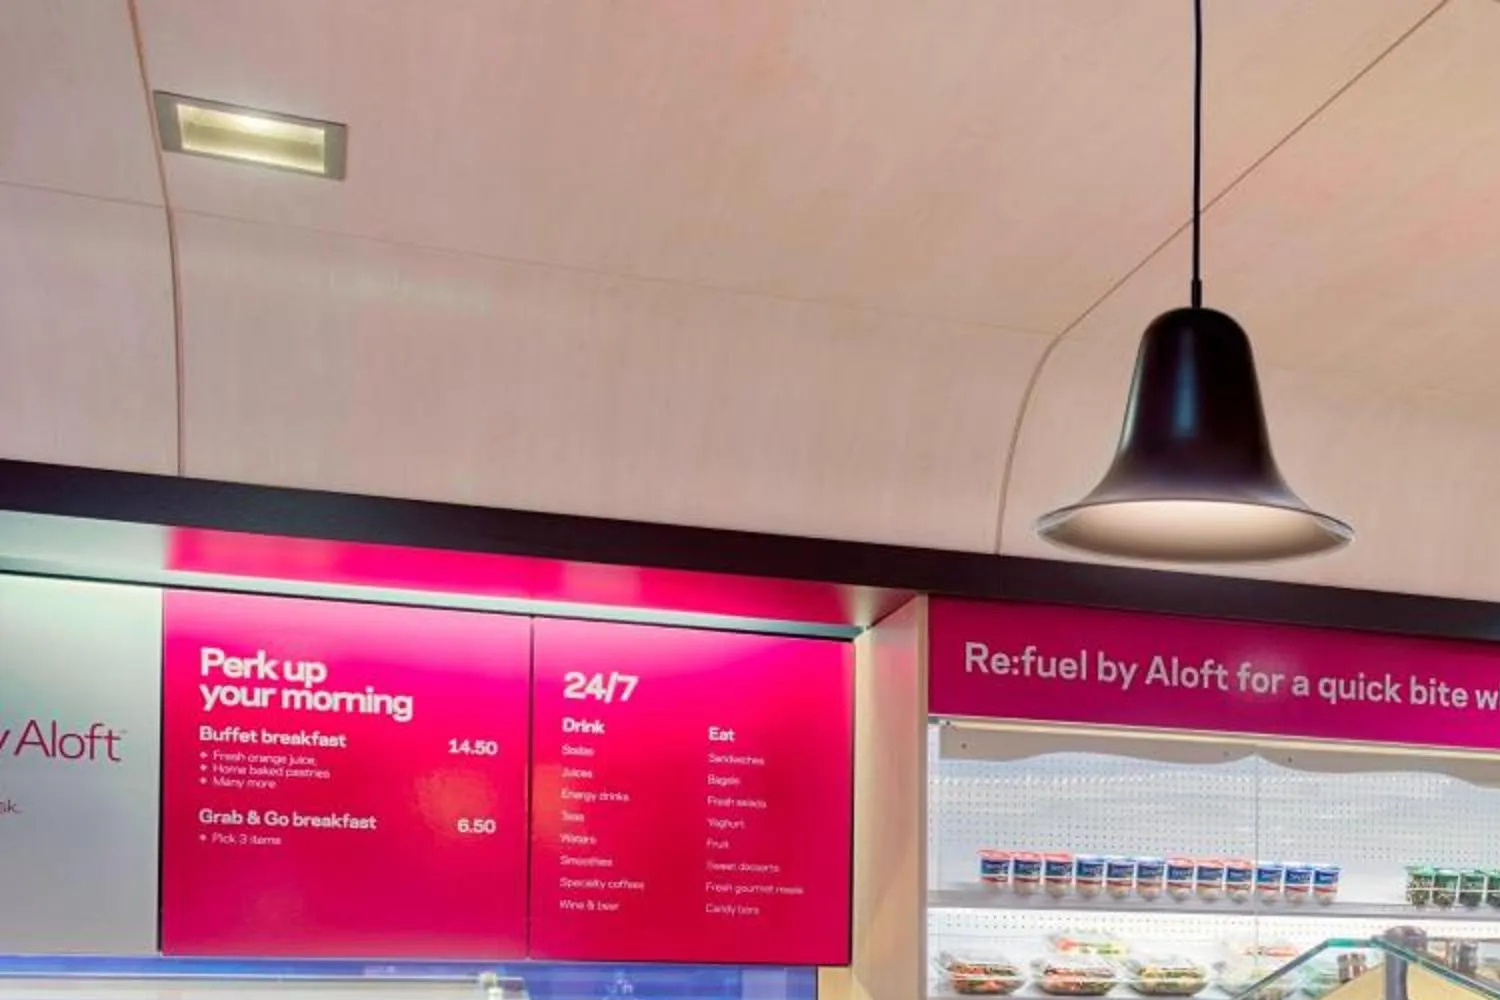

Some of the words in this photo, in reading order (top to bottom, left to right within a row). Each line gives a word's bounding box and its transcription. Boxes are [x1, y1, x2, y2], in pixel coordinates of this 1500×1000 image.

[200, 647, 279, 682] Perk
[283, 658, 327, 688] up
[964, 641, 1088, 681] Re:fuel
[1097, 651, 1138, 690] by
[1145, 655, 1229, 692] Aloft
[1236, 663, 1285, 694] for
[1292, 675, 1309, 696] a
[1318, 672, 1401, 705] quick
[1409, 676, 1469, 708] bite
[563, 671, 638, 703] 24/7
[200, 681, 276, 712] your
[281, 686, 413, 723] morning
[561, 717, 605, 734] Drink
[708, 726, 735, 742] Eat
[13, 719, 122, 762] Aloft
[200, 726, 257, 743] Buffet
[261, 729, 347, 748] breakfast
[448, 738, 498, 756] 14.50
[213, 750, 245, 762] Fresh
[248, 754, 286, 766] orange
[289, 755, 316, 766] juice
[708, 753, 765, 766] Sandwiches
[212, 764, 246, 775] Home
[249, 766, 283, 777] baked
[286, 769, 330, 780] pastries
[212, 777, 245, 789] Many
[248, 778, 277, 789] more
[561, 788, 597, 803] Energy
[599, 789, 630, 802] drinks
[199, 808, 243, 824] Grab
[247, 811, 260, 826] &
[264, 811, 289, 827] Go
[293, 812, 376, 831] breakfast
[457, 818, 496, 835] 6.50
[211, 832, 235, 844] Pick
[239, 834, 248, 844] 3
